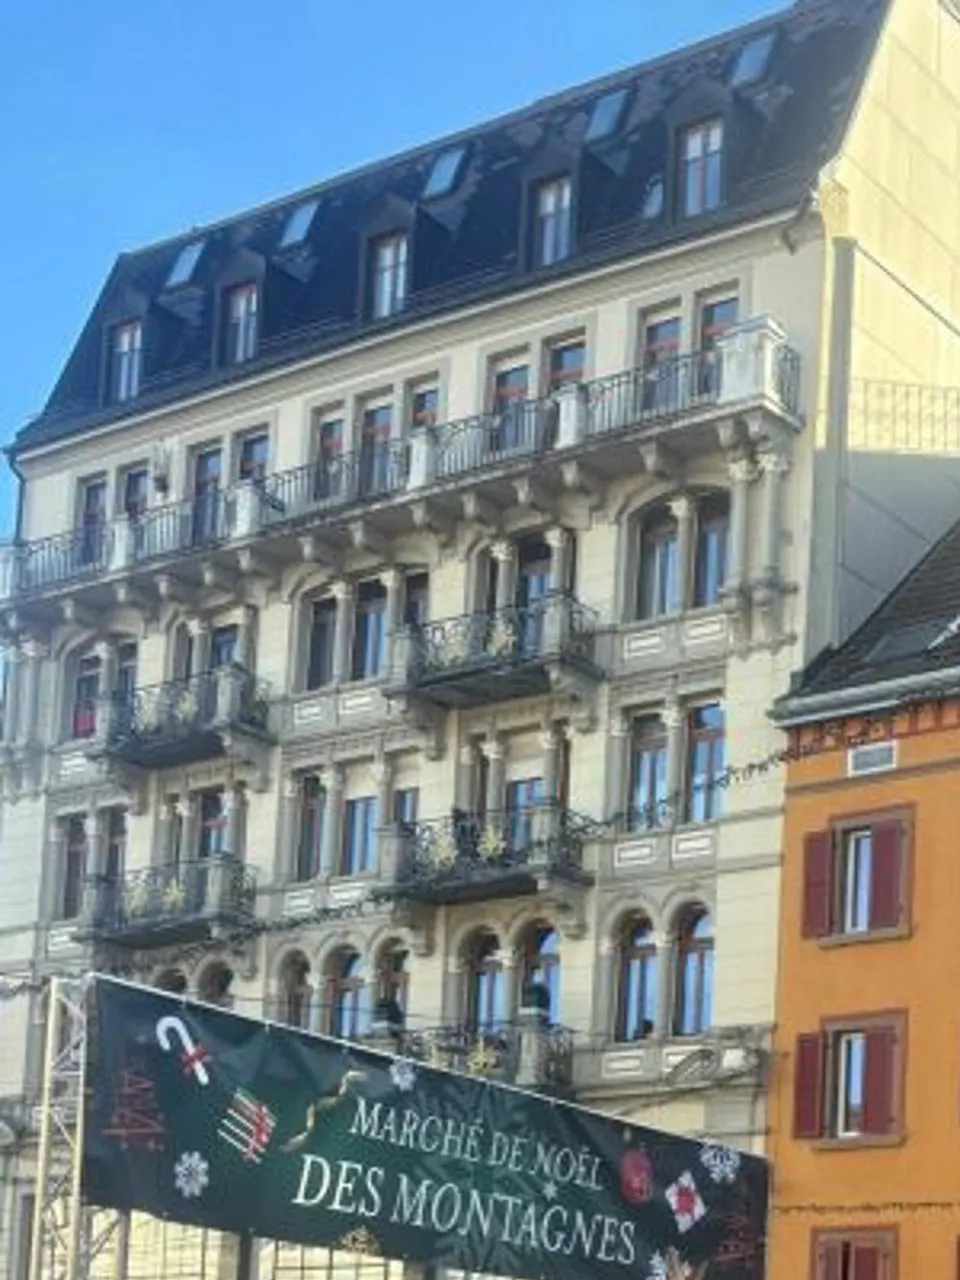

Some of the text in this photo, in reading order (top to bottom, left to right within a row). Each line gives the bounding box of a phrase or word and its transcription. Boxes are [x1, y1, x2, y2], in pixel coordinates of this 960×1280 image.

[351, 1097, 484, 1162] MARCHÉ
[489, 1131, 528, 1173] DE
[292, 1153, 636, 1265] DES MONTAGNES
